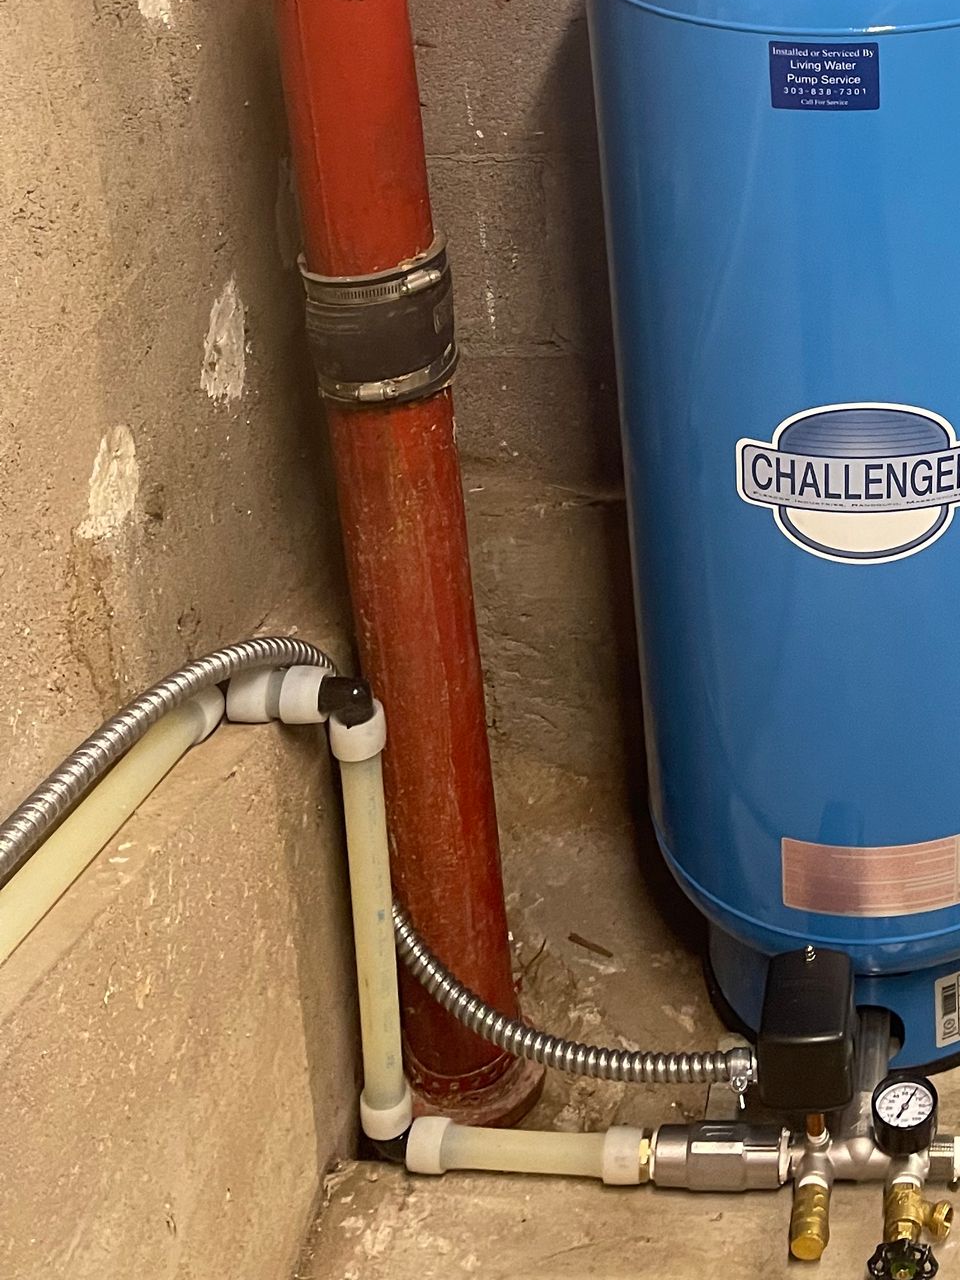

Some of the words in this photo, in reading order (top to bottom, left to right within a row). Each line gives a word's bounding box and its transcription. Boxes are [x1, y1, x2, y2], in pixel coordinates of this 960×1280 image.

[772, 46, 809, 57] Installed
[810, 49, 820, 57] or
[822, 48, 860, 58] Serviced
[862, 48, 875, 58] By
[790, 59, 822, 72] Living
[824, 60, 857, 71] Water
[787, 73, 818, 85] Pump
[820, 75, 861, 85] Service
